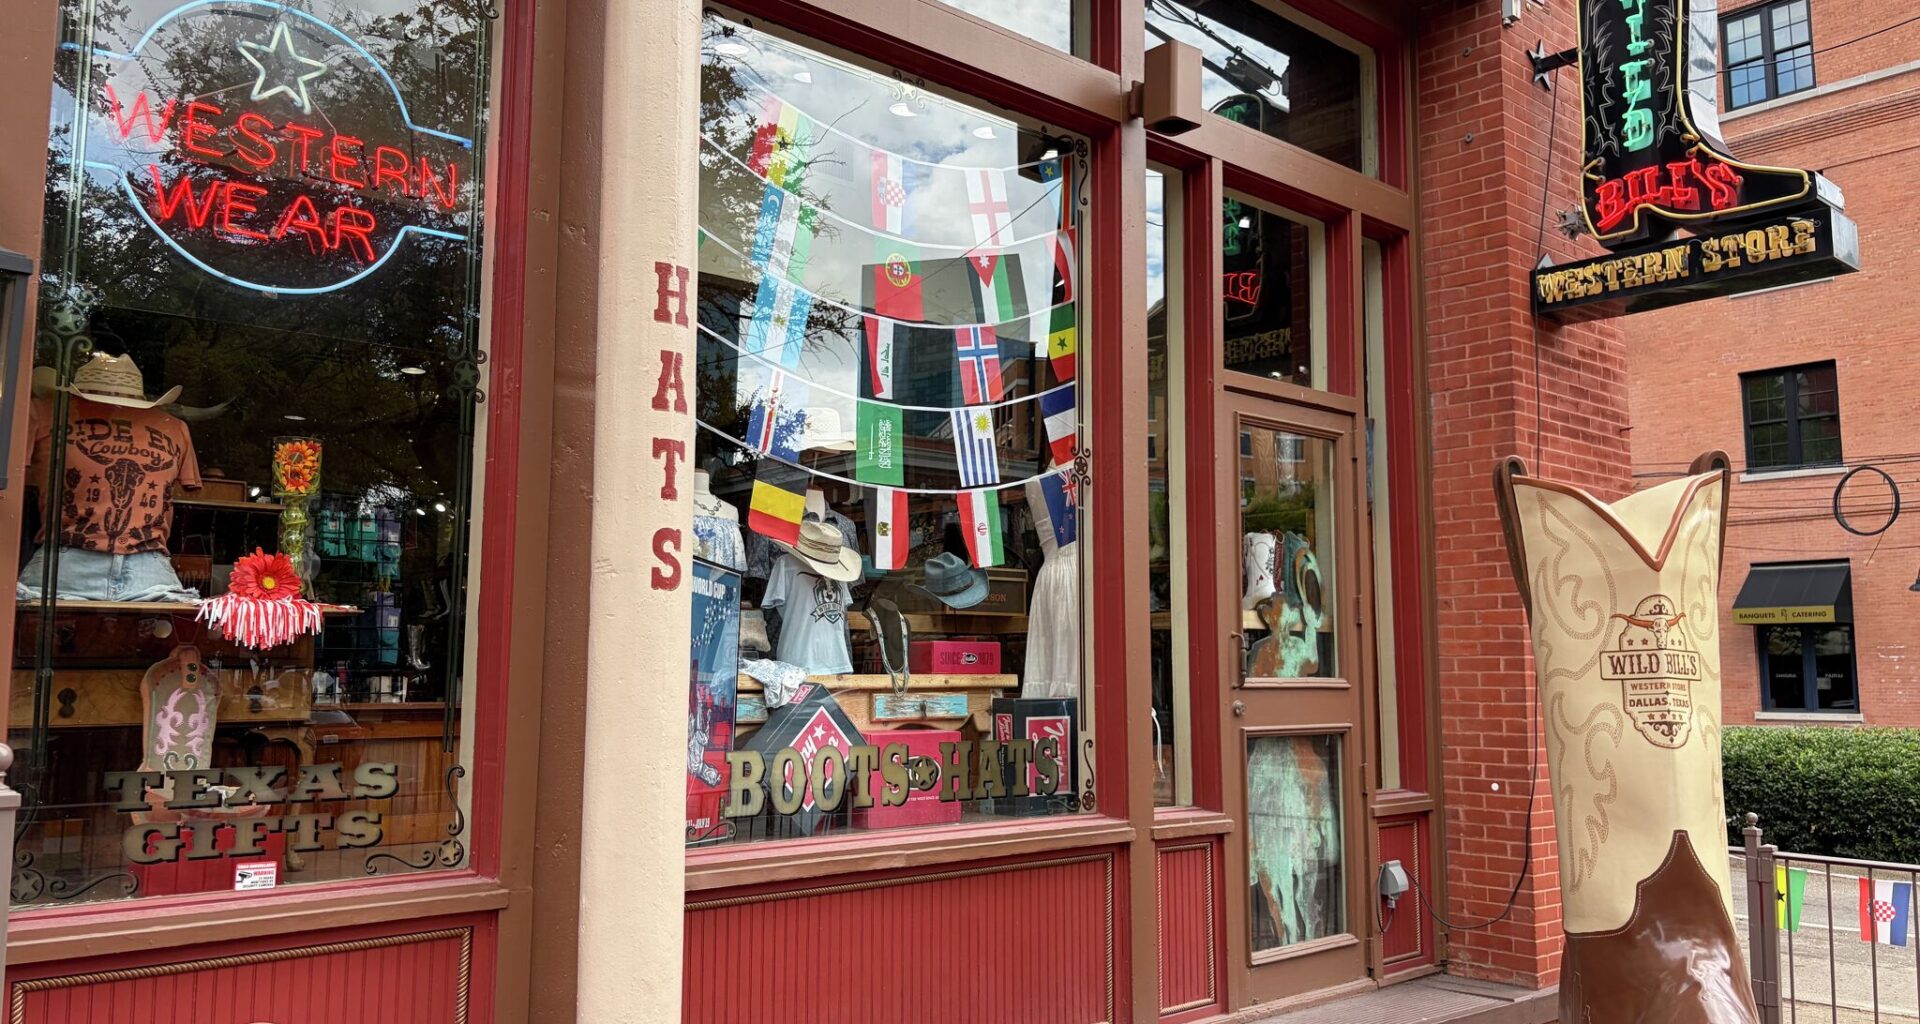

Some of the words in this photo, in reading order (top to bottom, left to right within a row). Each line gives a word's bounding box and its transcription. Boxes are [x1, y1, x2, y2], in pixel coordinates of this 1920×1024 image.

[1619, 0, 1655, 152] ILD
[106, 82, 457, 209] WESTERN
[150, 163, 376, 262] WEAR
[1595, 158, 1742, 231] BILL'S
[1537, 245, 1691, 303] WESTERN
[1701, 217, 1817, 272] STORE
[90, 441, 165, 466] Cowboy
[651, 261, 689, 592] HATS
[86, 488, 100, 502] 19
[139, 493, 158, 508] 46
[1739, 612, 1776, 620] BANQUETS
[1792, 611, 1827, 619] CATERING
[1608, 652, 1660, 675] WILD
[1664, 653, 1697, 676] BILL'S
[1630, 682, 1671, 691] WESTERN
[1672, 698, 1689, 708] TEXAS
[104, 762, 399, 813] TEXAS
[726, 742, 910, 818] BOOTS
[938, 737, 1060, 802] HATS
[123, 810, 384, 865] GIFTS
